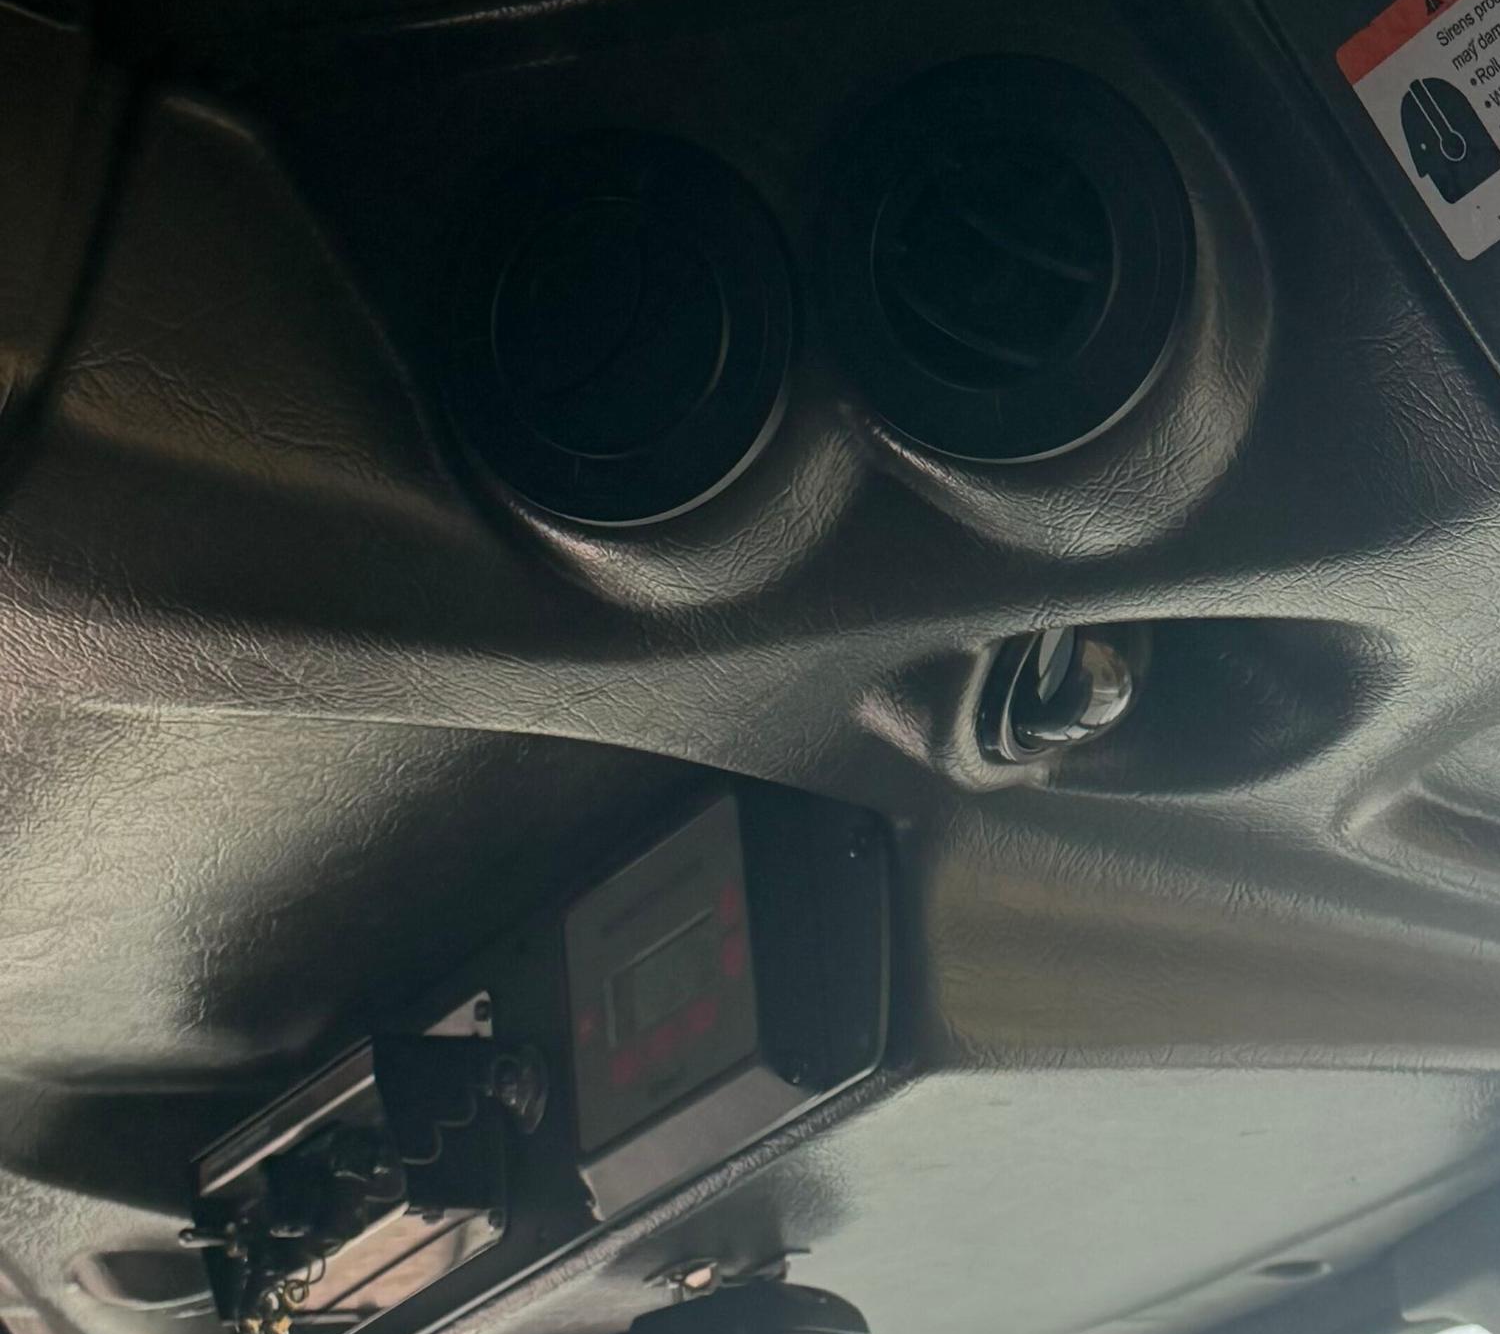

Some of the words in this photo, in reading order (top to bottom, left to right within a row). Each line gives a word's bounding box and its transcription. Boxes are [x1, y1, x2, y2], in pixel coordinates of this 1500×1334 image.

[1436, 12, 1475, 46] Sirens
[1451, 40, 1478, 70] may
[1474, 56, 1500, 84] Roll
